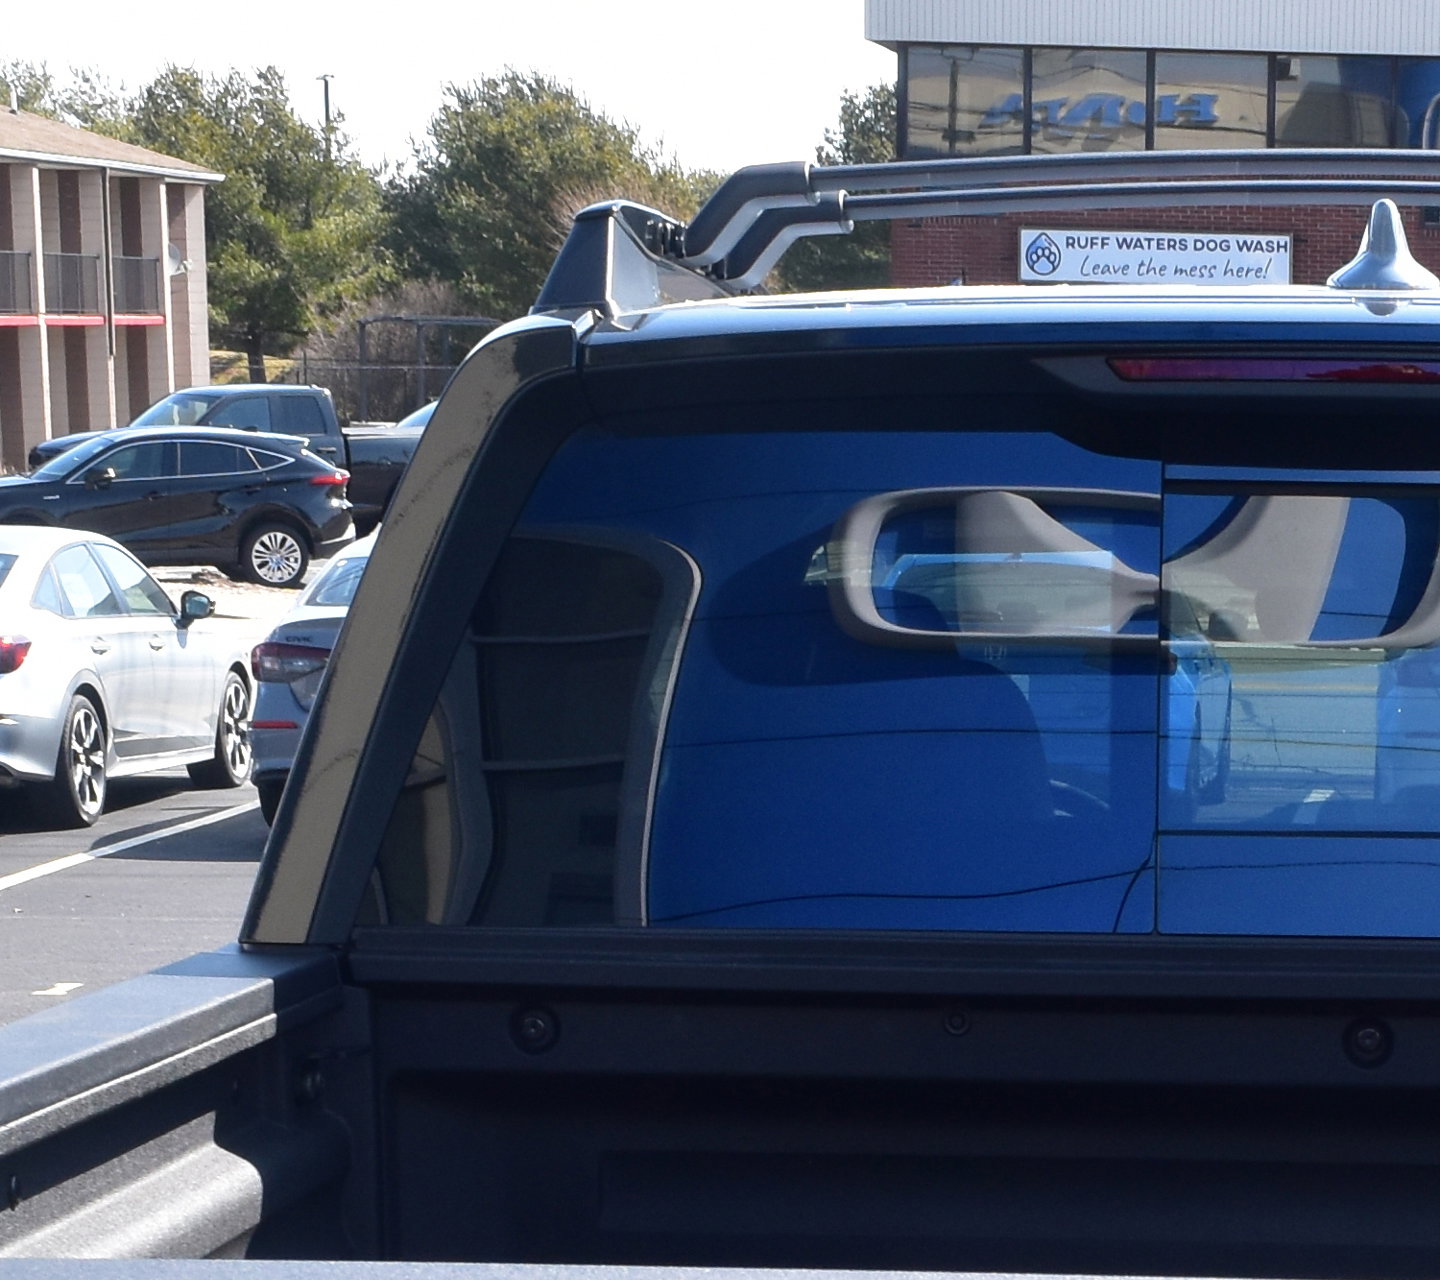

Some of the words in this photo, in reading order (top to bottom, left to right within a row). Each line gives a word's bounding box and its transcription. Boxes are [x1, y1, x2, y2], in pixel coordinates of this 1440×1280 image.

[1065, 236, 1111, 250] RUFF
[1116, 237, 1188, 252] WATERS
[1193, 238, 1231, 253] DOG
[1235, 239, 1289, 254] WASH
[1079, 255, 1130, 277] Leave
[1136, 257, 1167, 277] the
[1173, 264, 1217, 279] mess
[1222, 258, 1272, 280] here!
